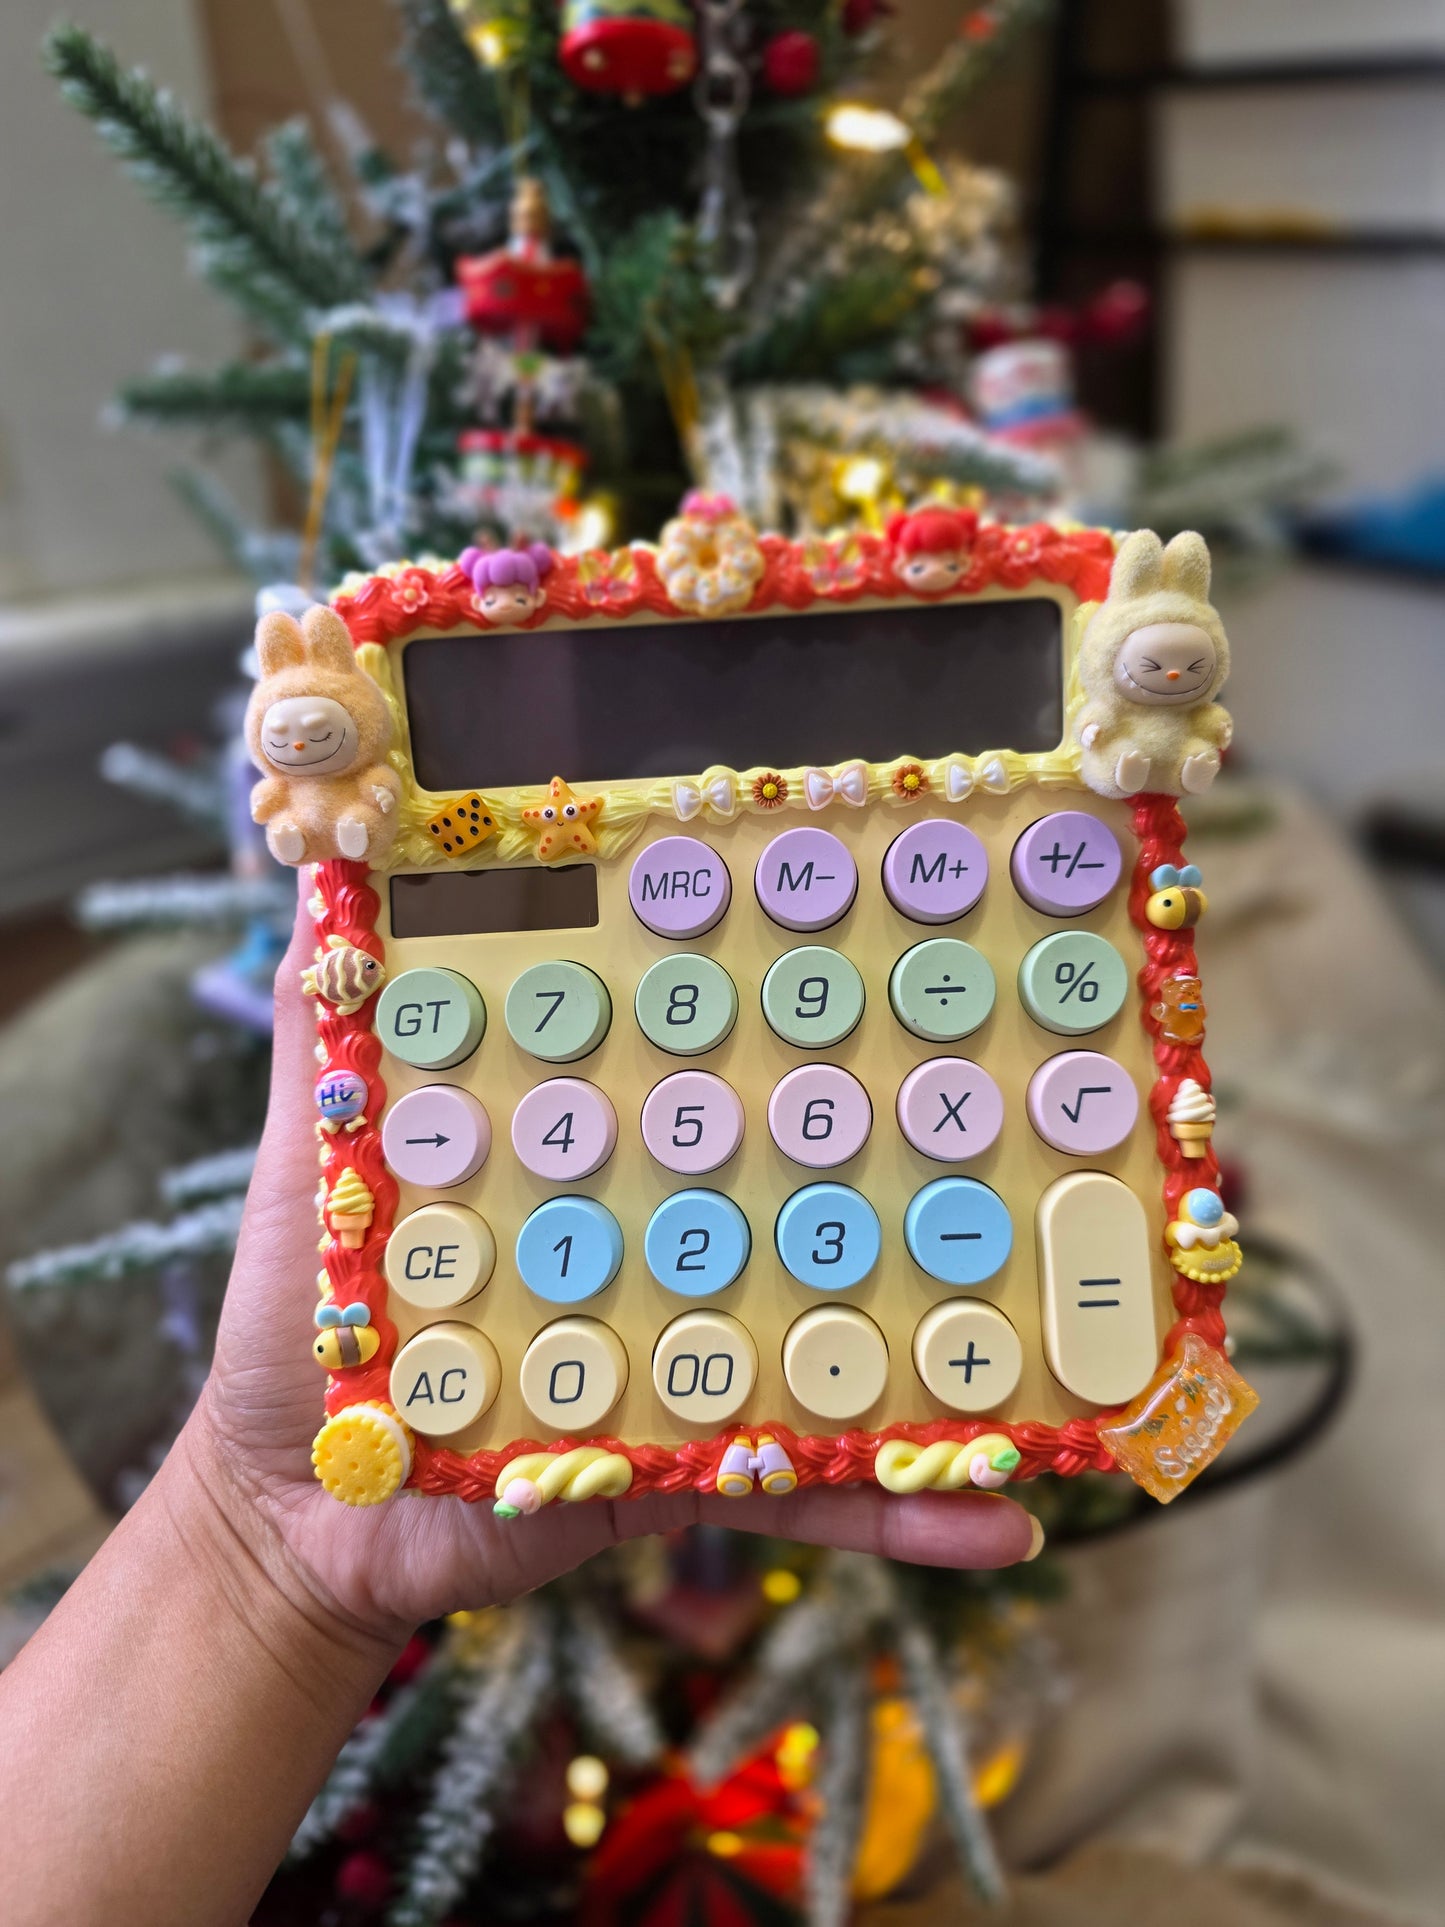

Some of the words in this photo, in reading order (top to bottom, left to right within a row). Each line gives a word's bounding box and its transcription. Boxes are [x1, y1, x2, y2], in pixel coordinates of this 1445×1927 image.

[642, 868, 712, 903] MRC
[909, 852, 969, 884] M+
[795, 976, 829, 1019] 9
[1054, 961, 1099, 1004] %
[394, 1000, 451, 1037] GT
[534, 991, 566, 1033] 7
[665, 984, 699, 1026] 8
[321, 1083, 355, 1107] Hi
[932, 1091, 972, 1133] X
[541, 1112, 575, 1154] 4
[672, 1105, 705, 1148] 5
[802, 1098, 835, 1141] 6
[405, 1244, 460, 1281] CE
[552, 1235, 574, 1278] 1
[675, 1228, 710, 1272] 2
[811, 1221, 846, 1265] 3
[405, 1368, 467, 1407] AC
[549, 1360, 585, 1404] 0
[666, 1352, 735, 1397] 00
